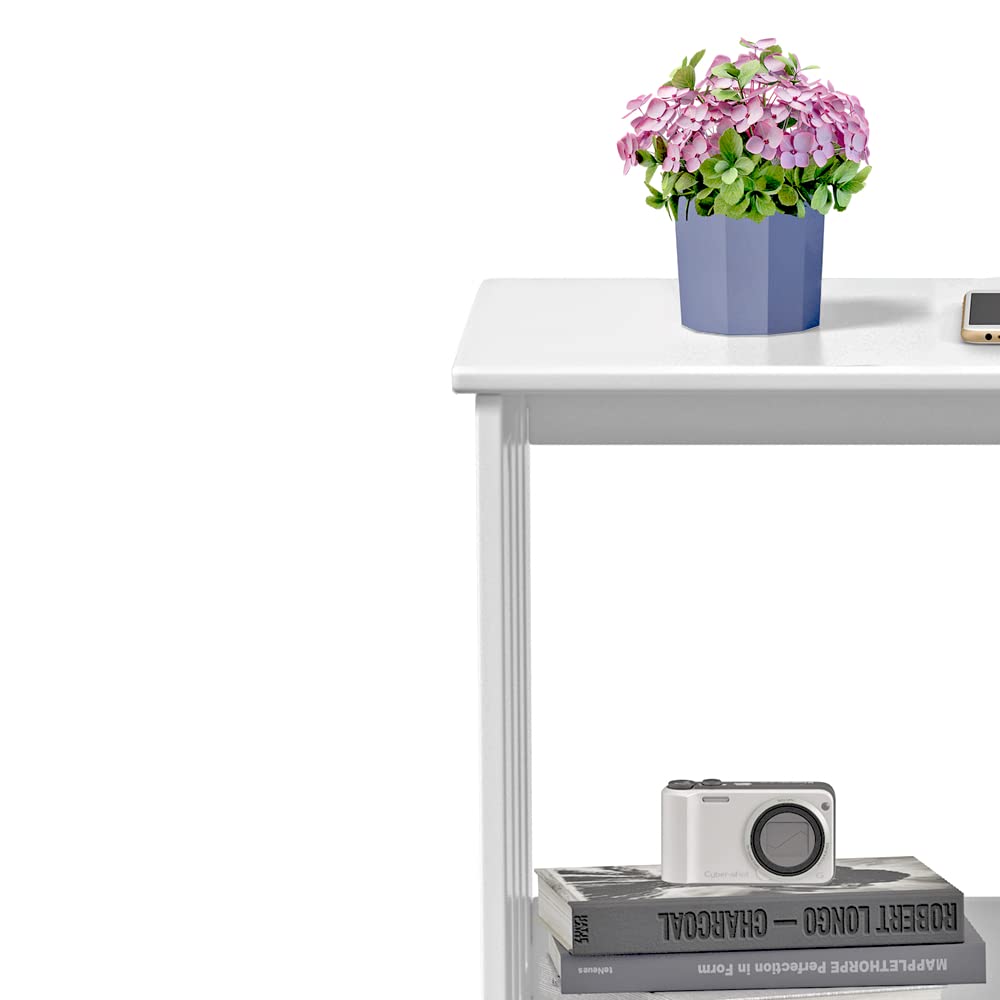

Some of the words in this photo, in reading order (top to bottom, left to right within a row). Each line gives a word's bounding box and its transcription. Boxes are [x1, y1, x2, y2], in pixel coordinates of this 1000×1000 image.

[657, 908, 768, 941] CHARCOAL
[803, 905, 870, 936] LONGO
[875, 902, 957, 933] ROBERT
[577, 966, 613, 976] teNeues
[697, 963, 734, 977] Form
[737, 963, 751, 976] in
[755, 961, 826, 975] Perfection
[830, 958, 948, 974] MAPPLETHORPE
